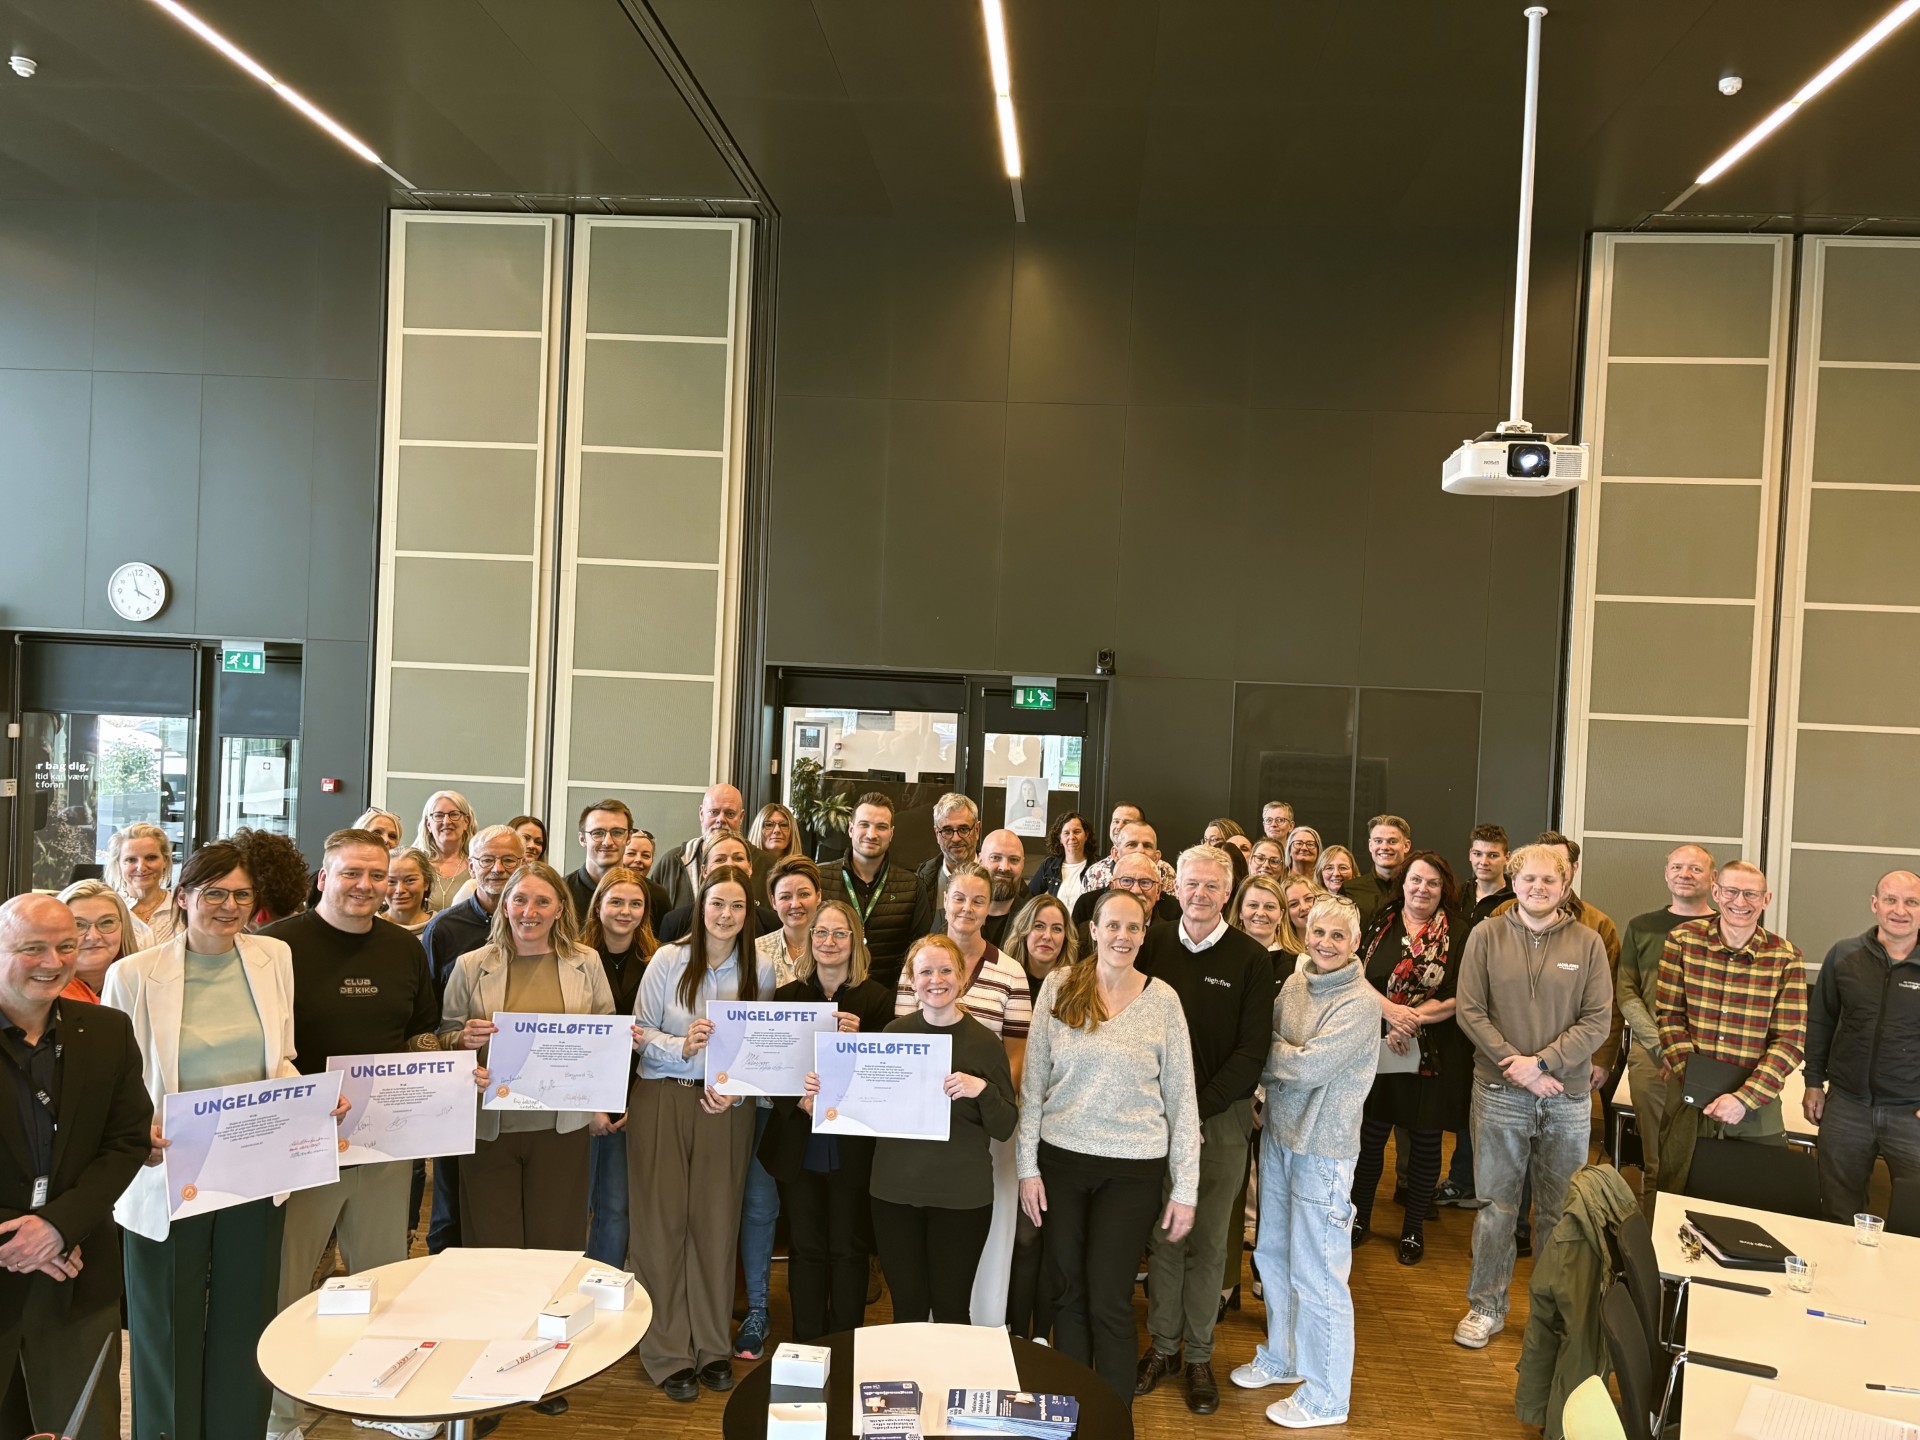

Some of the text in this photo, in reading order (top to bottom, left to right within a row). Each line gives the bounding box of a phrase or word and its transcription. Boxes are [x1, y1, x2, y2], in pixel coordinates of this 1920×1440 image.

[45, 762, 66, 772] bag
[68, 762, 89, 772] dig,
[344, 978, 371, 986] CLUB
[355, 986, 378, 994] KIKO
[727, 1010, 817, 1022] UNGELØFTET
[515, 1022, 613, 1035] UNGELØFTET
[836, 1042, 930, 1055] UNGELØFTET
[351, 1061, 455, 1078] UNGELØFTET
[194, 1084, 316, 1116] UNGELØFTET
